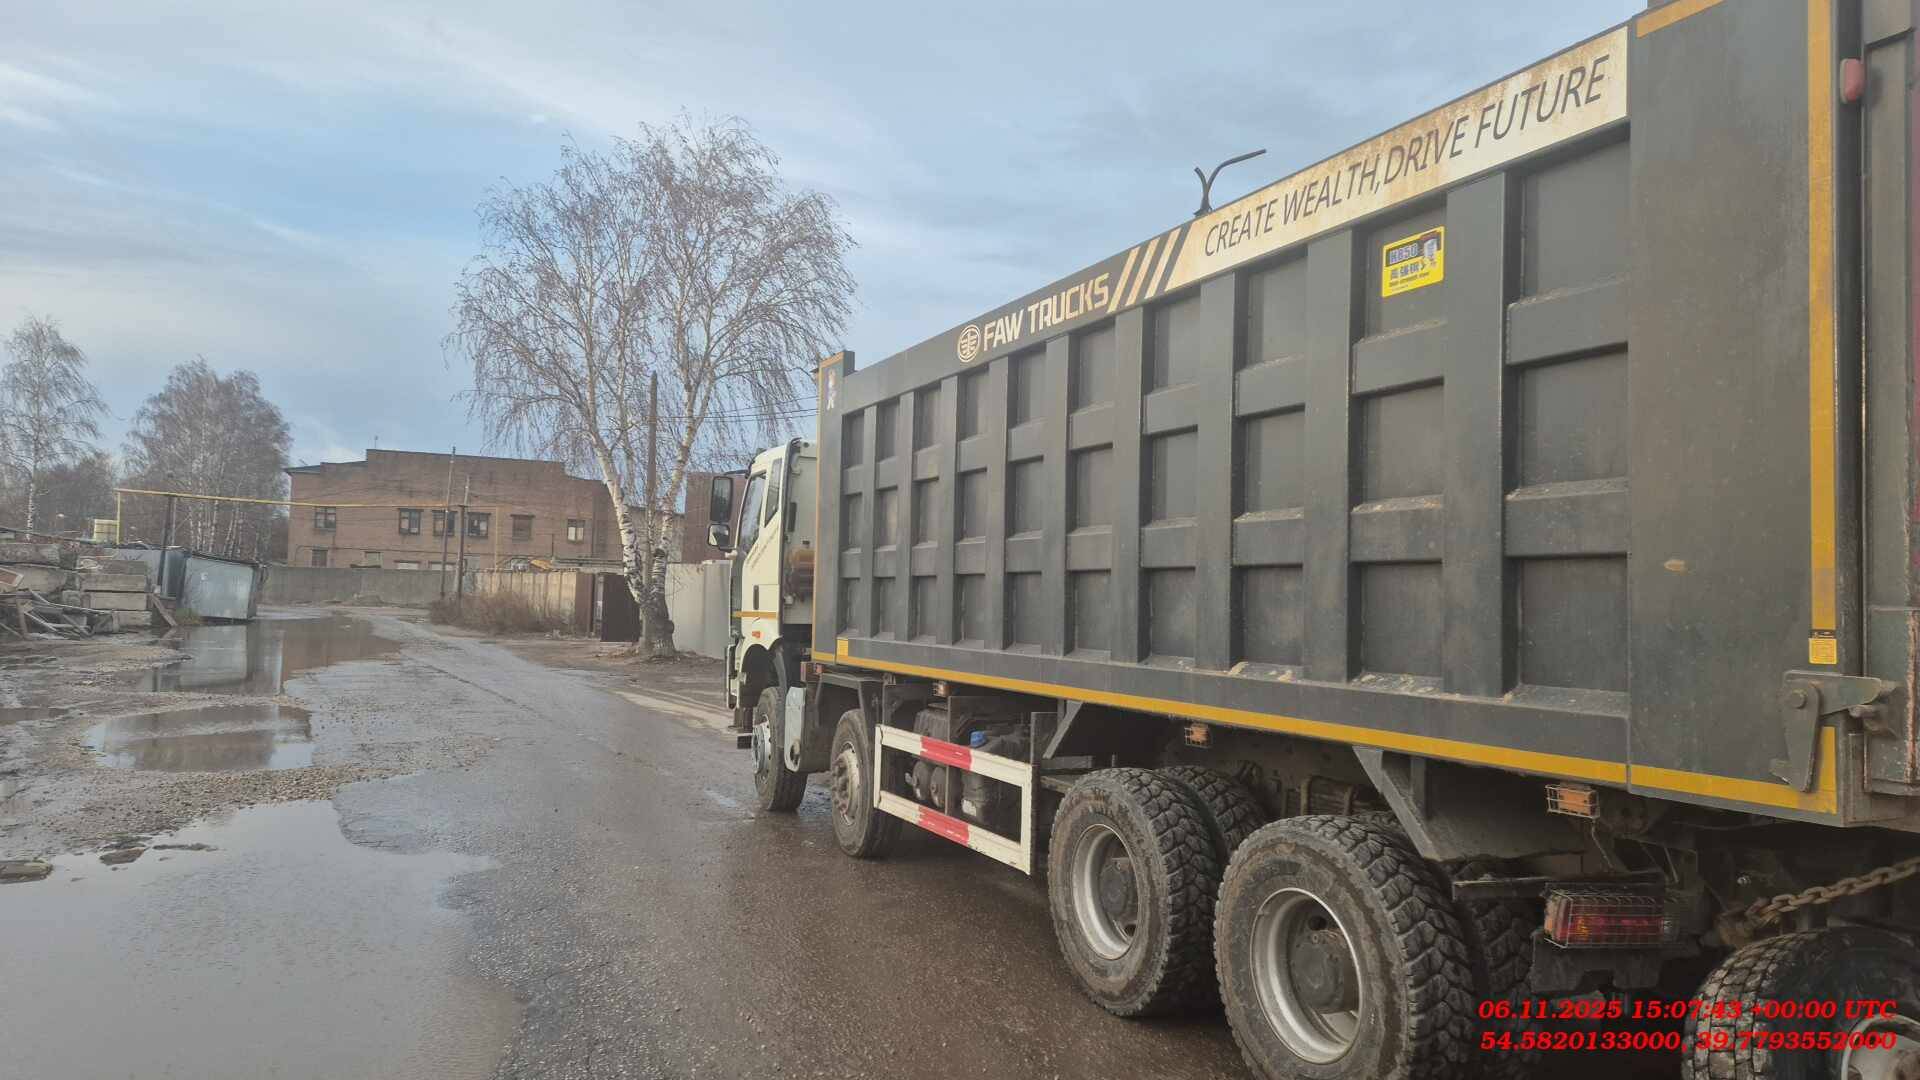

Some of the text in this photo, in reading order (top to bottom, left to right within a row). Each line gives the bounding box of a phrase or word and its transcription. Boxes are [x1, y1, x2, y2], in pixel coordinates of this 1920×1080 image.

[1204, 198, 1279, 257] CREATE
[1474, 54, 1610, 149] FUTURE
[983, 272, 1111, 352] FAW TRUCKS
